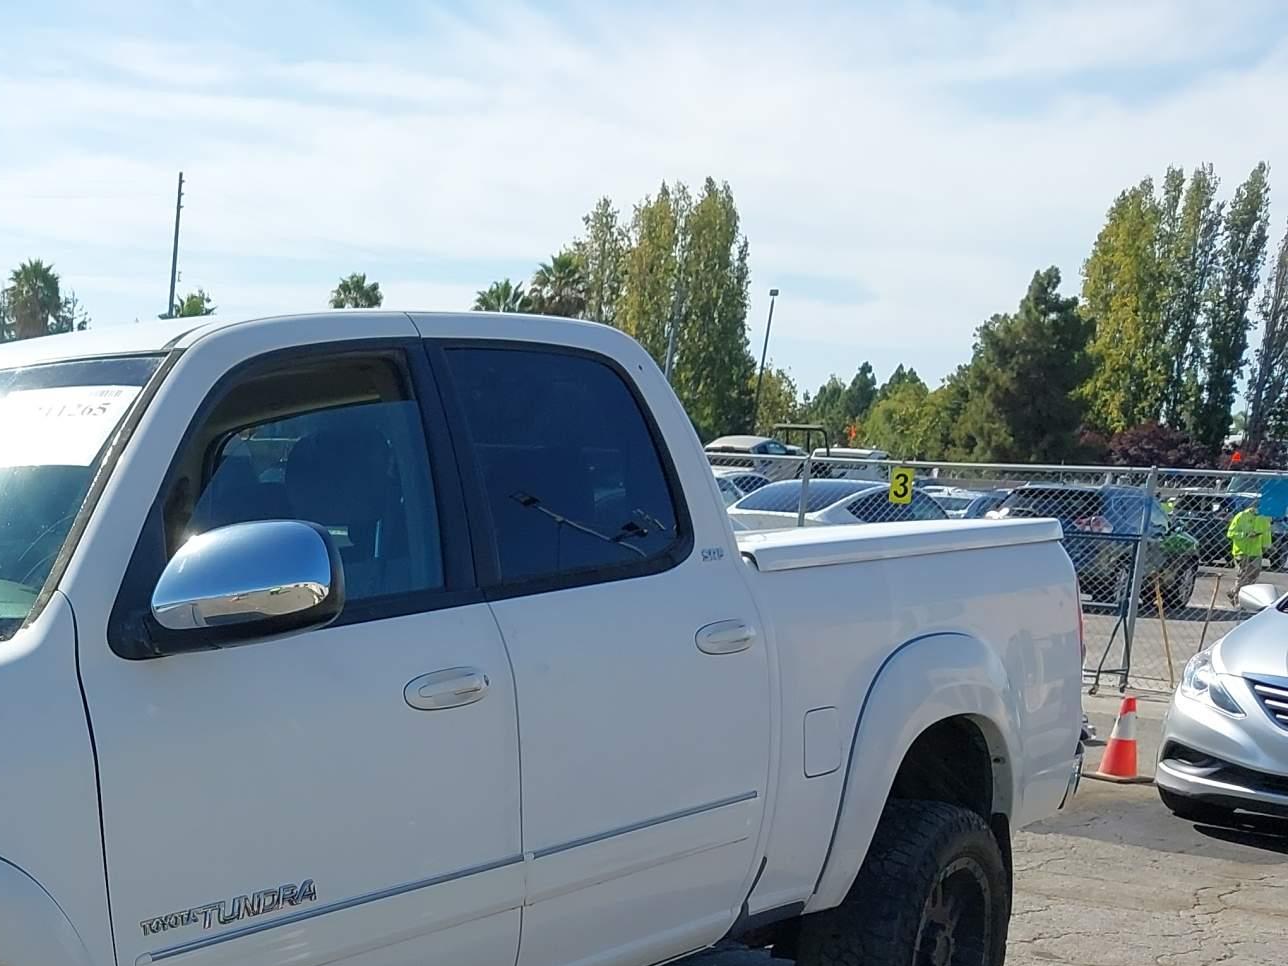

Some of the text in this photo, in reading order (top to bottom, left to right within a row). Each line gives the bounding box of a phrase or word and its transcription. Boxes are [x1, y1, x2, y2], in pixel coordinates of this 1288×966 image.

[893, 473, 909, 499] 3
[140, 878, 317, 936] TOYOTA TUNDRA
